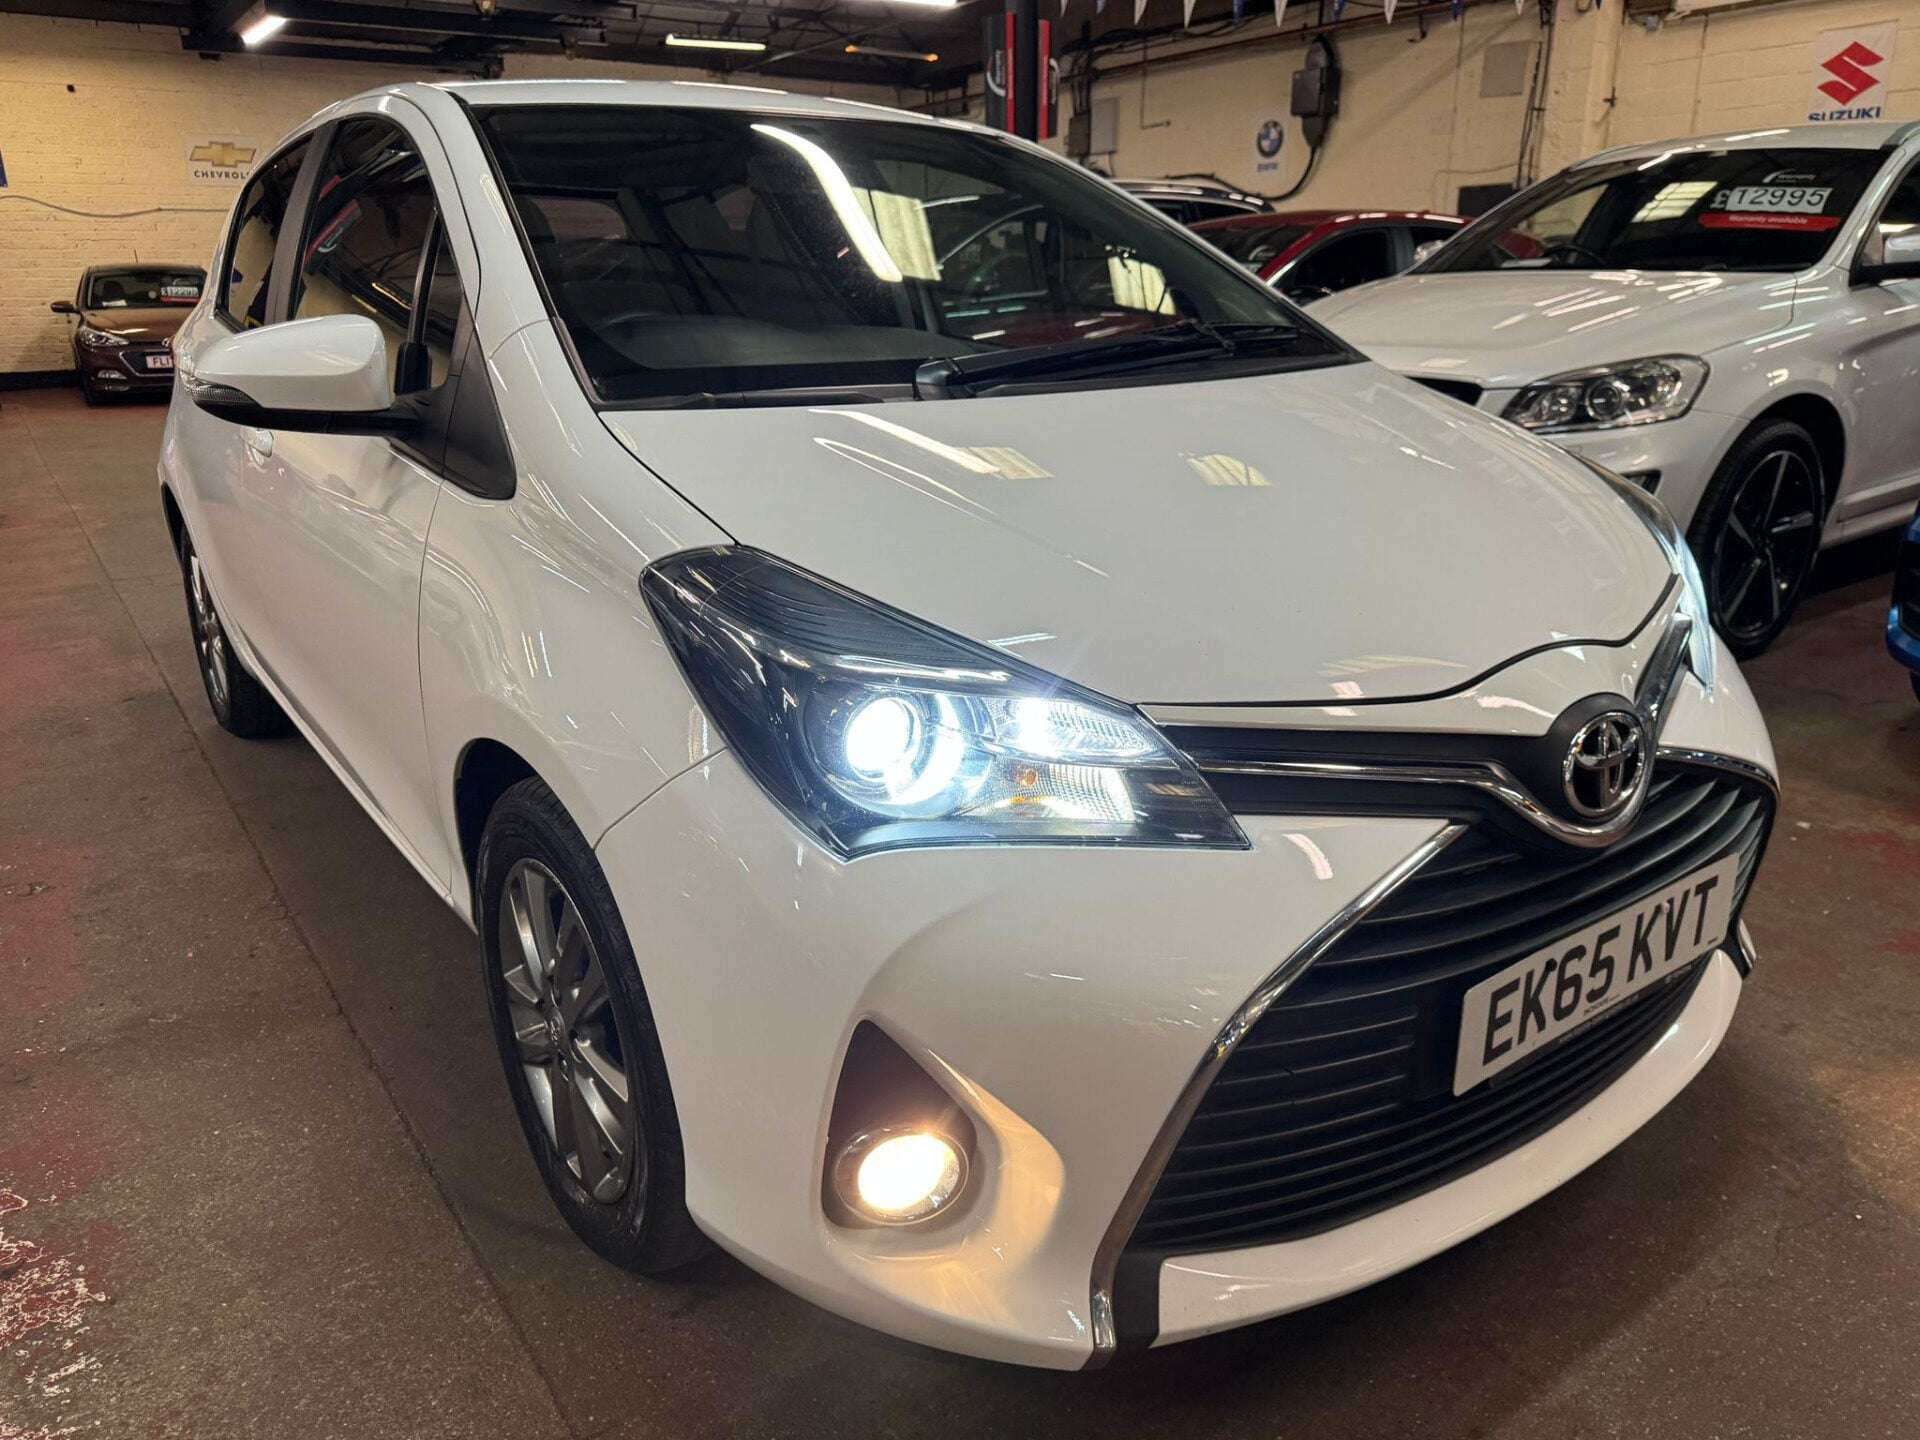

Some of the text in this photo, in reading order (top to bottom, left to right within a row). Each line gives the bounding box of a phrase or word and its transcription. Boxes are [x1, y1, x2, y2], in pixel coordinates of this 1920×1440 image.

[1807, 106, 1882, 121] SUZUKI
[194, 170, 249, 180] CHEVROL
[1482, 875, 1719, 1067] EK65 KVT
